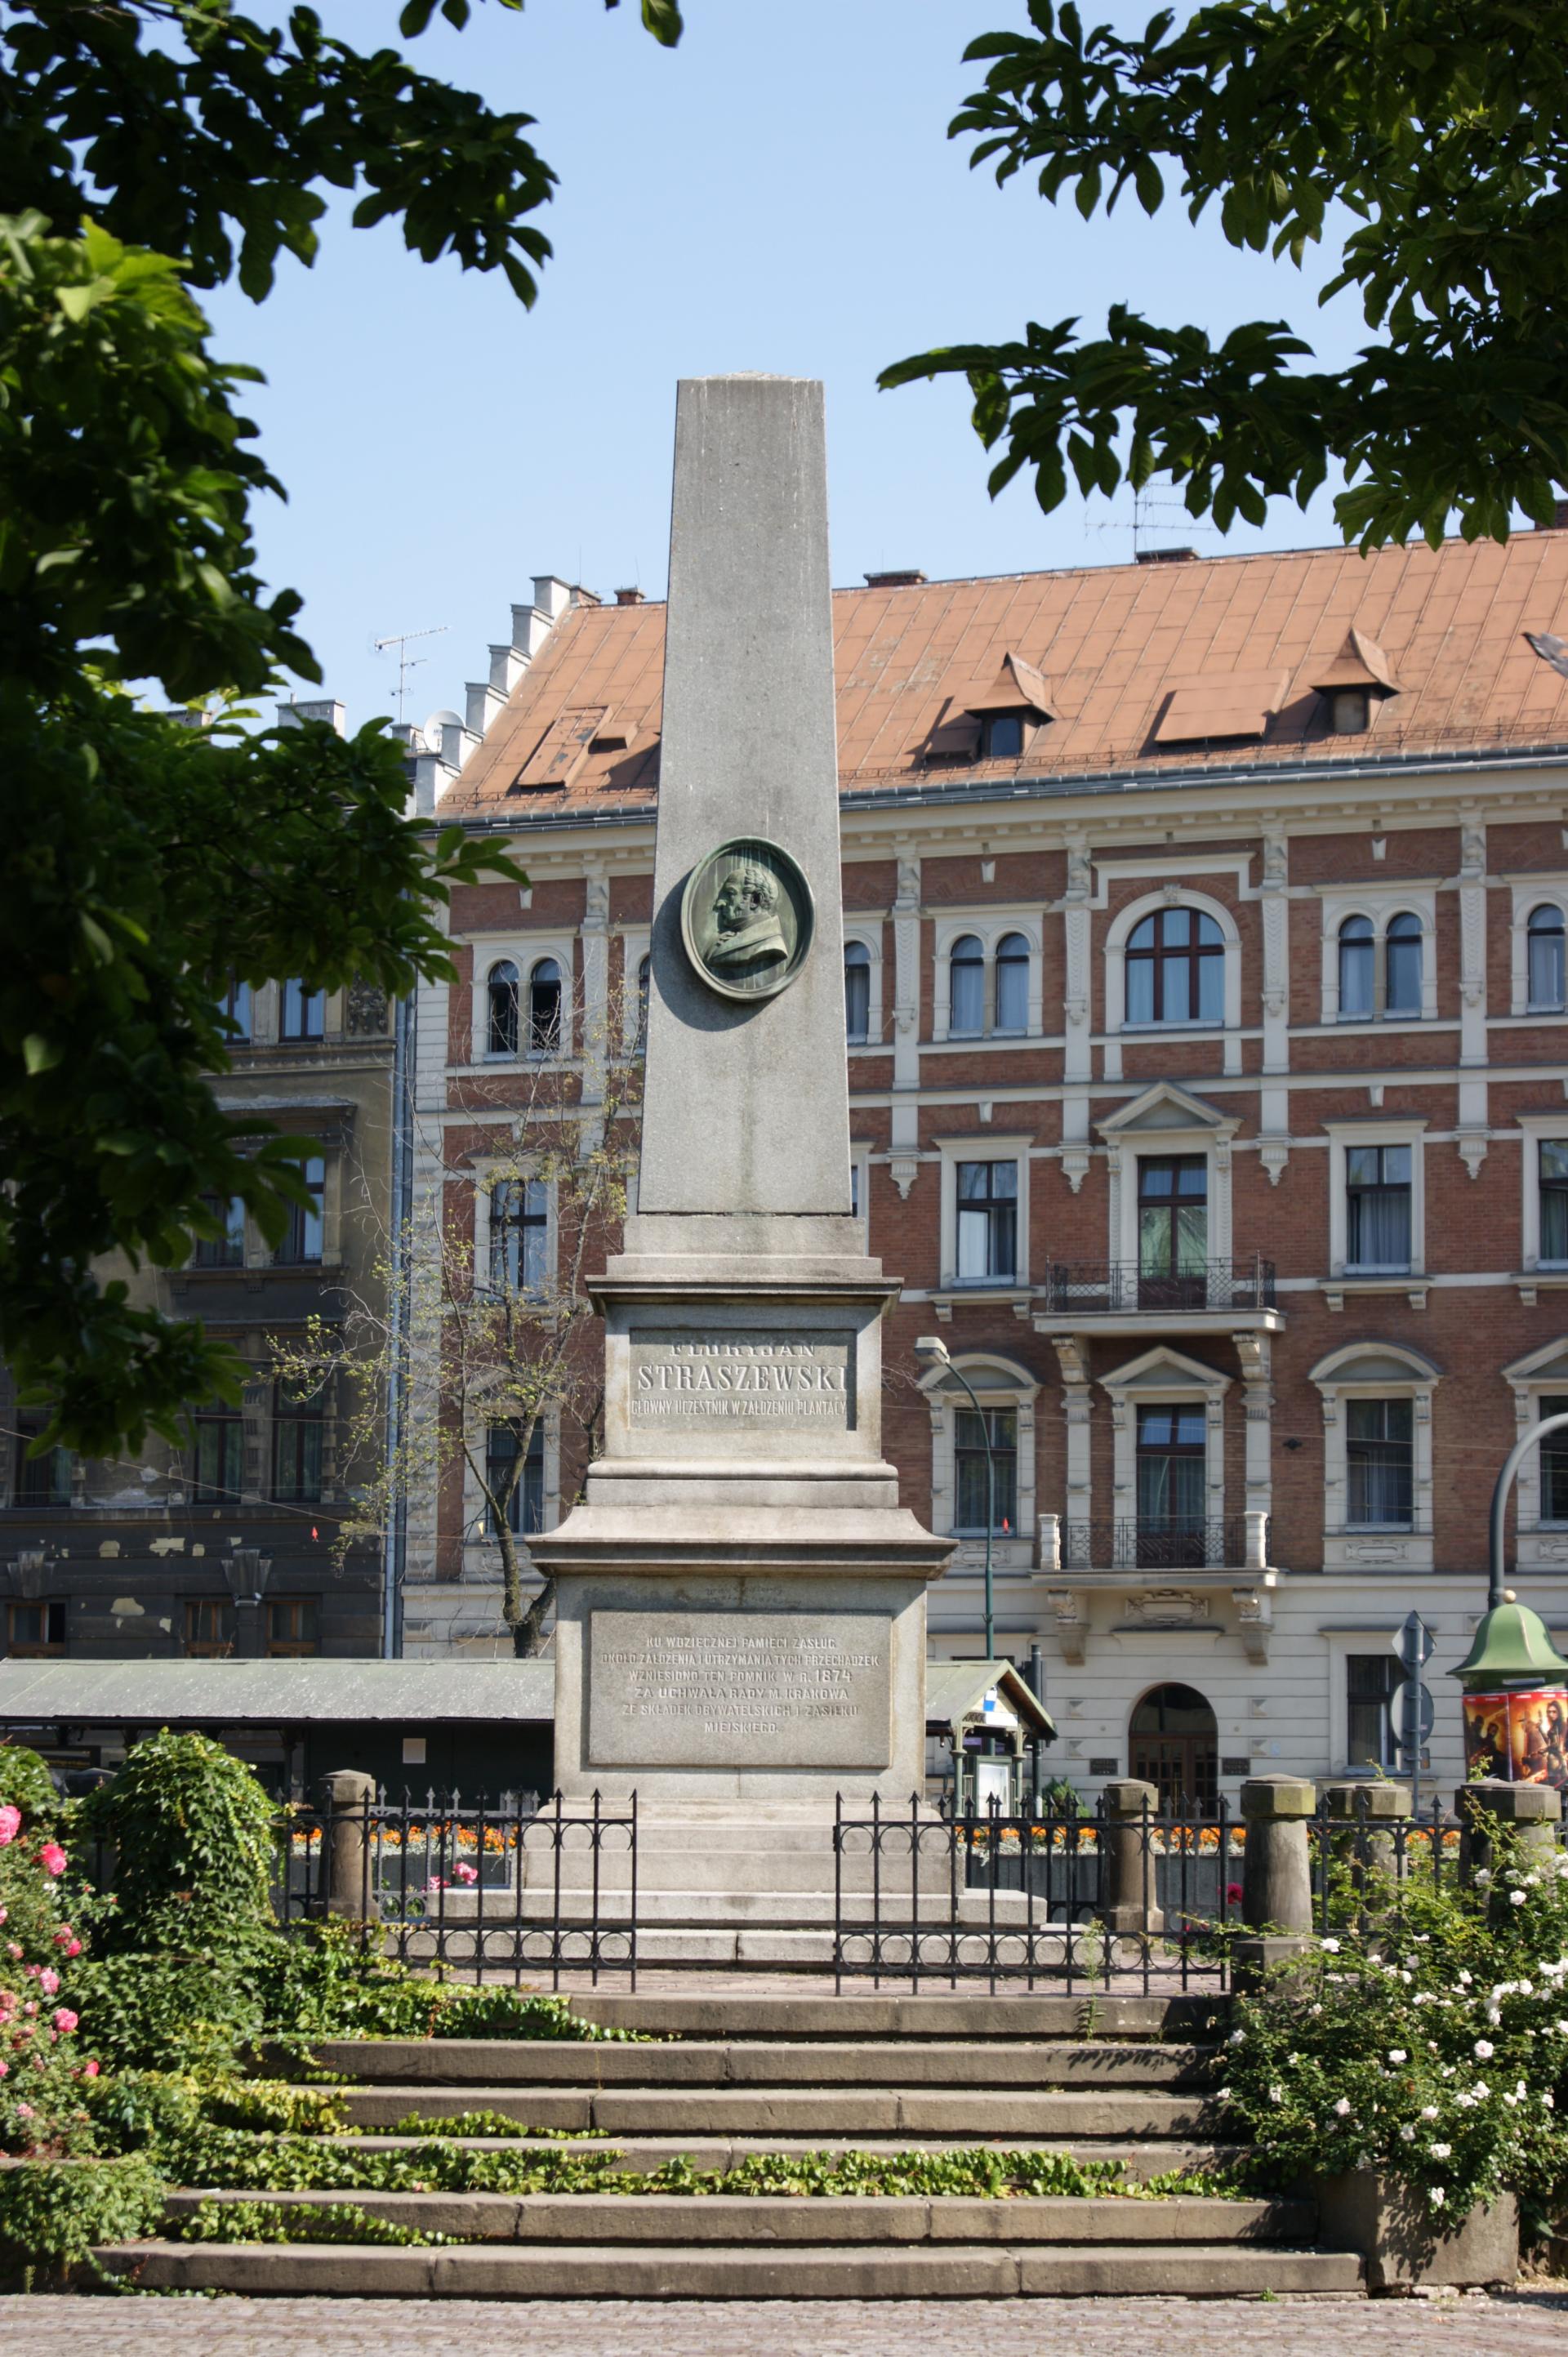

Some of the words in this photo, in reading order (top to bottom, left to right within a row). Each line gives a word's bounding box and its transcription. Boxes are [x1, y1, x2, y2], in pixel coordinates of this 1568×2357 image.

[638, 1365, 848, 1392] STRASZEWSKI
[675, 1399, 729, 1415] UCZESTNIK
[732, 1399, 740, 1415] W
[647, 1637, 662, 1648] KU
[705, 1653, 773, 1666] UTRZYMANIA
[775, 1655, 803, 1666] TYCH
[805, 1655, 880, 1667] PRZECHADZEK
[630, 1670, 700, 1682] WZNIESIONO
[703, 1670, 726, 1682] TEN
[730, 1671, 777, 1683] POMNIK
[783, 1671, 795, 1682] W
[800, 1671, 813, 1683] R.
[816, 1668, 853, 1683] 1874
[635, 1686, 654, 1699] ZA
[730, 1687, 766, 1700] RADY
[786, 1688, 849, 1700] KRAKOWA
[622, 1704, 637, 1714] ZE
[697, 1704, 791, 1717] OBYWATELSKICH
